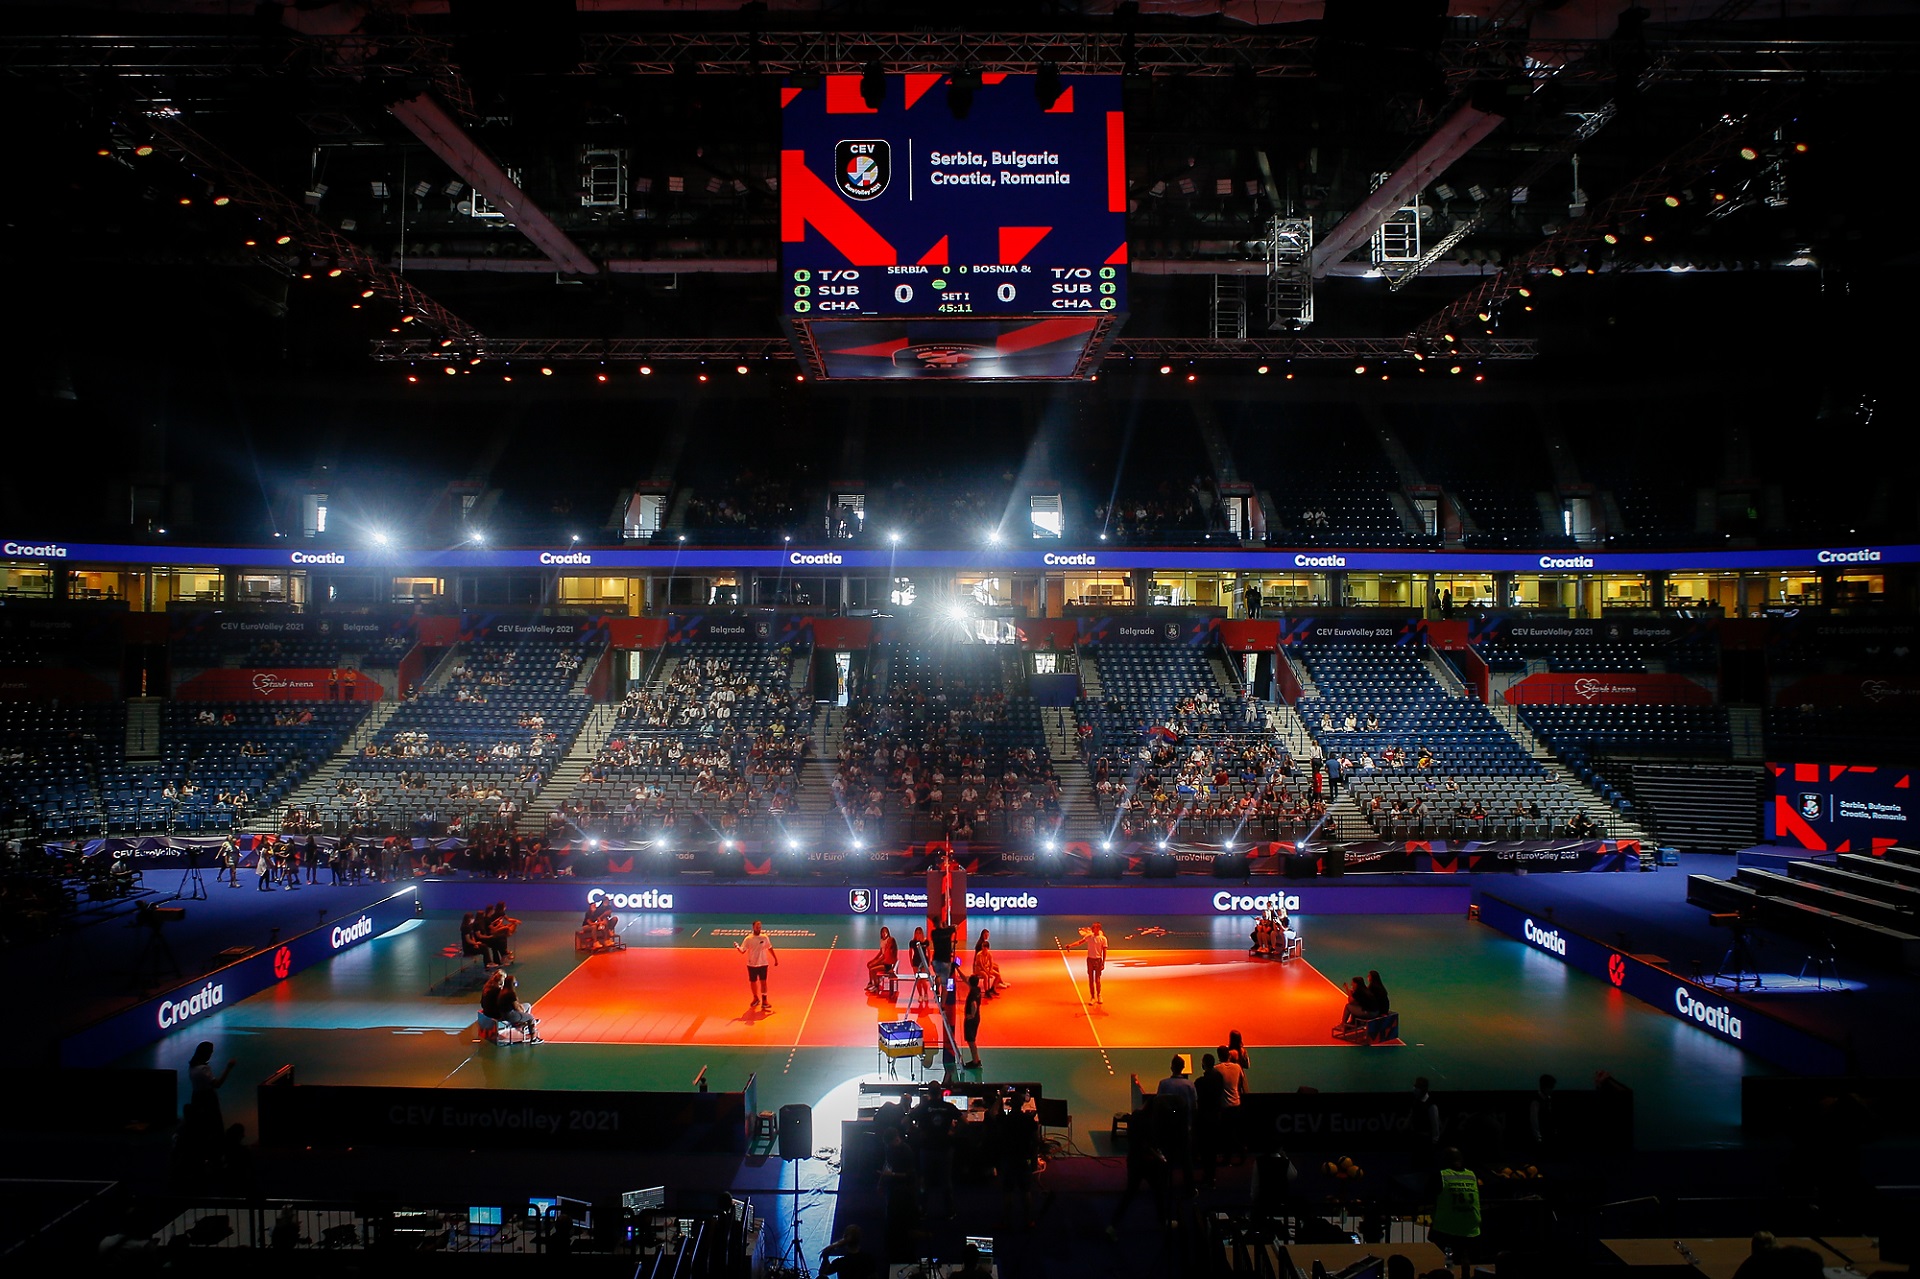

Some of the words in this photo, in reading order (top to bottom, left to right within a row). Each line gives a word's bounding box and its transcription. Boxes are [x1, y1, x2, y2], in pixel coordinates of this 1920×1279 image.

[850, 144, 875, 154] CEV
[930, 151, 988, 167] Serbia,
[992, 151, 1059, 168] Bulgaria
[930, 171, 997, 187] Croatia,
[1001, 170, 1070, 185] Romania
[794, 269, 811, 282] 0
[818, 270, 860, 281] T/O
[887, 266, 928, 274] SERBIA
[942, 266, 951, 274] 0
[959, 266, 968, 274] 0
[972, 266, 1018, 274] BOSNIA
[1020, 266, 1032, 274] &
[1050, 268, 1092, 279] T/O
[1099, 267, 1116, 279] 0
[794, 284, 811, 297] 0
[818, 285, 860, 296] SUB
[894, 284, 914, 303] 0
[997, 283, 1016, 302] 0
[1052, 284, 1092, 294] SUB
[1099, 282, 1116, 295] 0
[941, 292, 962, 301] SET
[794, 300, 811, 313] 0
[818, 301, 861, 311] CHA
[938, 304, 973, 313] 45:11
[1052, 299, 1093, 308] CHA
[1099, 297, 1116, 310] 0
[4, 543, 66, 557] Croatia
[1818, 549, 1880, 562] Croatia
[292, 552, 345, 563] Croatia
[540, 552, 591, 564] Croatia
[790, 552, 842, 564] Croatia
[1044, 553, 1095, 565] Croatia
[1295, 555, 1345, 566] Croatia
[1540, 556, 1593, 568] Croatia
[240, 622, 284, 632] EuroVolley
[343, 623, 379, 632] Belgrade
[515, 625, 555, 634] EuroVolley
[556, 625, 574, 633] 2021
[710, 625, 746, 635] Belgrade
[1119, 627, 1155, 637] Belgrade
[1317, 628, 1334, 636] CEV
[1334, 627, 1374, 637] EuroVolley
[1375, 628, 1393, 636] 2021
[1511, 627, 1529, 636] CEV
[1530, 627, 1573, 638] EuroVolley
[1574, 627, 1594, 636] 2021
[1633, 627, 1671, 638] Belgrade
[1611, 685, 1636, 694] Arena
[1001, 852, 1035, 863] Belgrad
[1173, 853, 1215, 863] uroVolley
[1497, 851, 1514, 860] CEV
[1515, 851, 1560, 861] EuroVolley
[965, 892, 1038, 912] Belgrade
[1213, 890, 1300, 911] Croatia
[330, 914, 372, 949] Croatia
[1524, 917, 1566, 956] Croatia
[157, 981, 223, 1030] Croatia
[1675, 986, 1743, 1040] Croatia
[387, 1104, 435, 1126] CEV
[441, 1105, 562, 1134] EuroVolley
[569, 1109, 621, 1130] 2021
[1274, 1112, 1324, 1134] CEV
